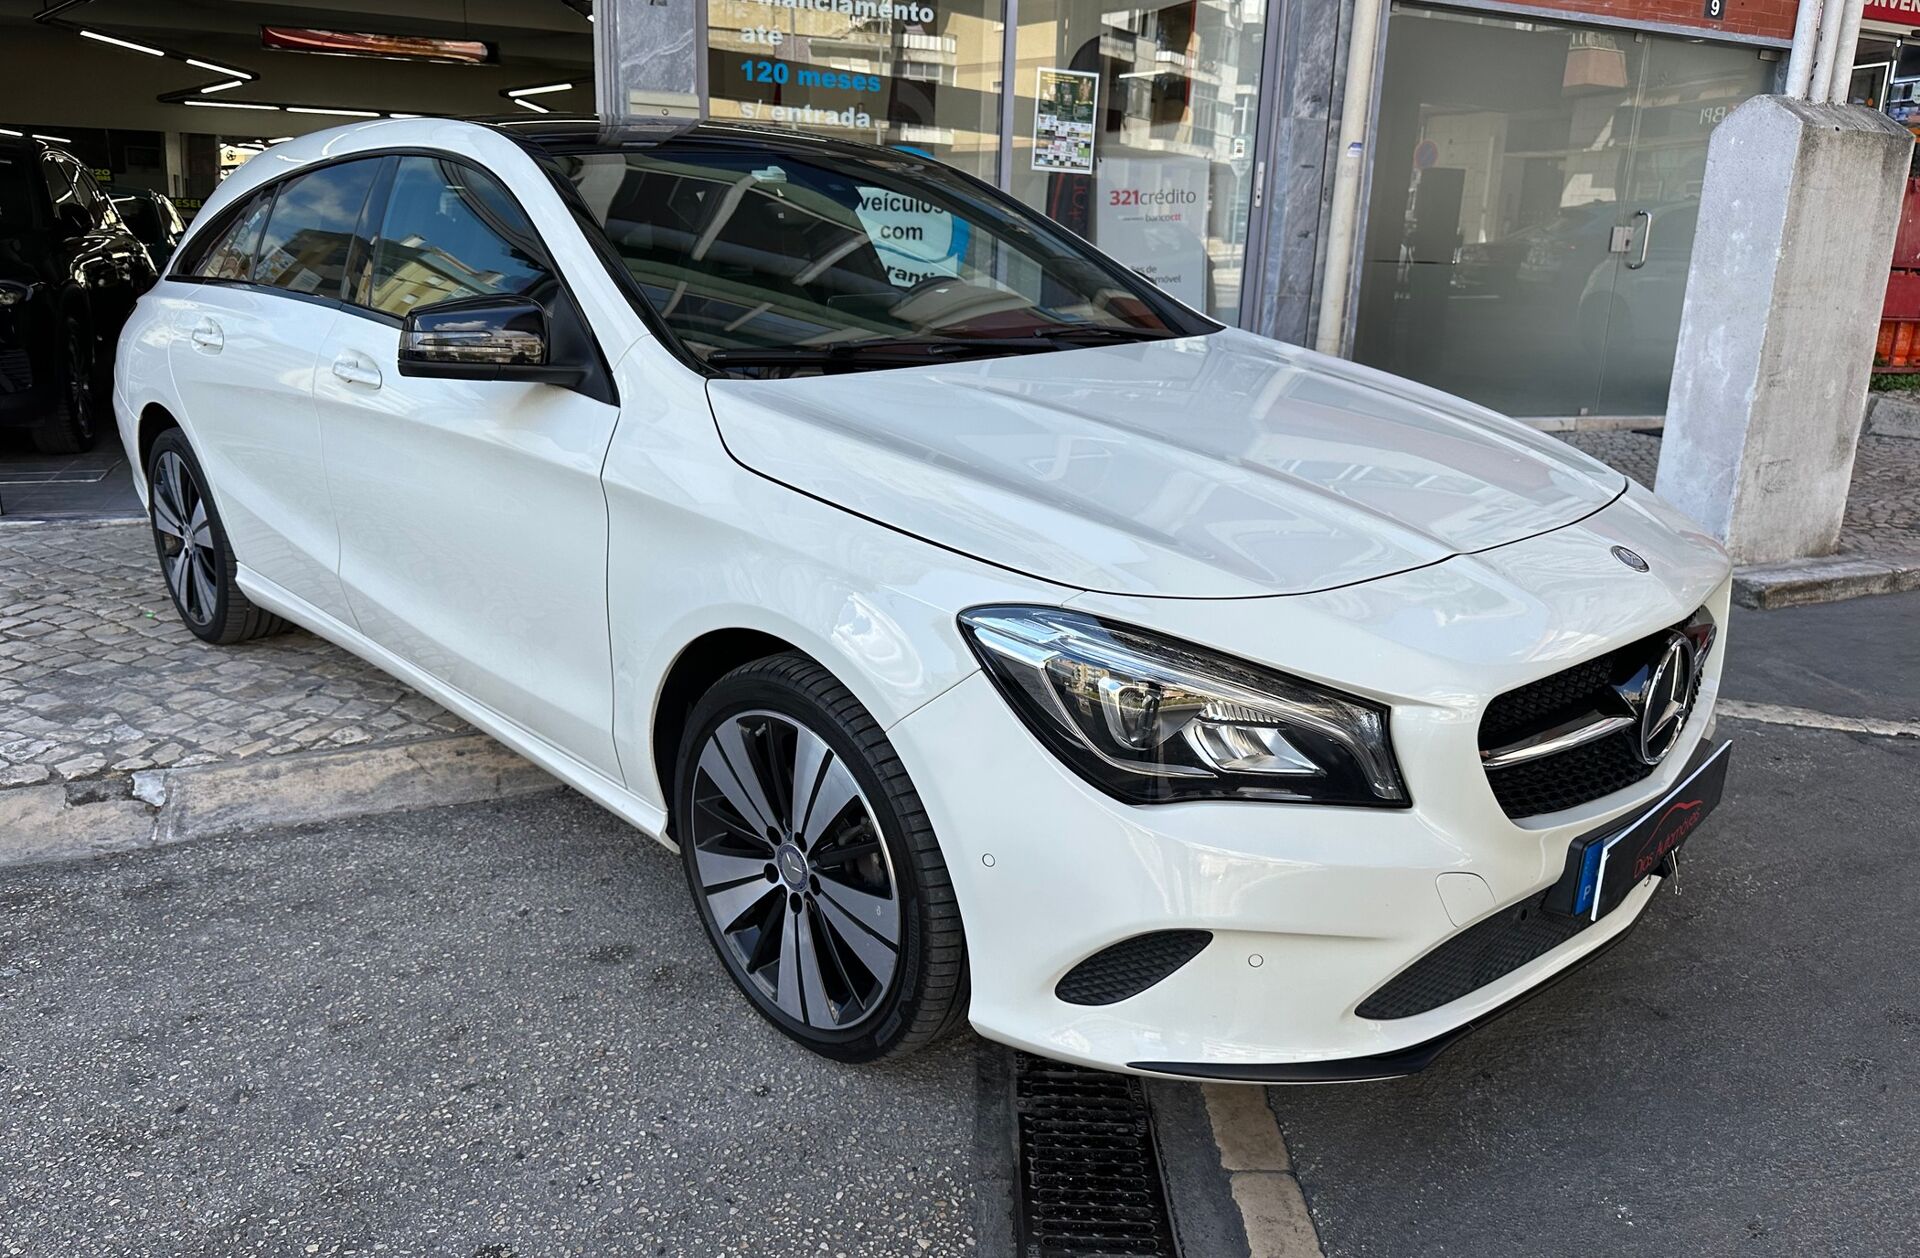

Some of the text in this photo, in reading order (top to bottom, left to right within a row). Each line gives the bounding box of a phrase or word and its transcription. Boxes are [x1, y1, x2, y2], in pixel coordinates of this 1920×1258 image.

[742, 0, 935, 22] anciamento
[1710, 0, 1720, 16] 9
[1863, 0, 1920, 13] VEN
[740, 24, 783, 46] até
[740, 60, 882, 92] 120 meses
[740, 99, 871, 128] s/ entrada
[173, 199, 203, 208] ESEL
[1109, 188, 1197, 206] 321crédito
[880, 225, 923, 241] com
[1583, 884, 1591, 900] P
